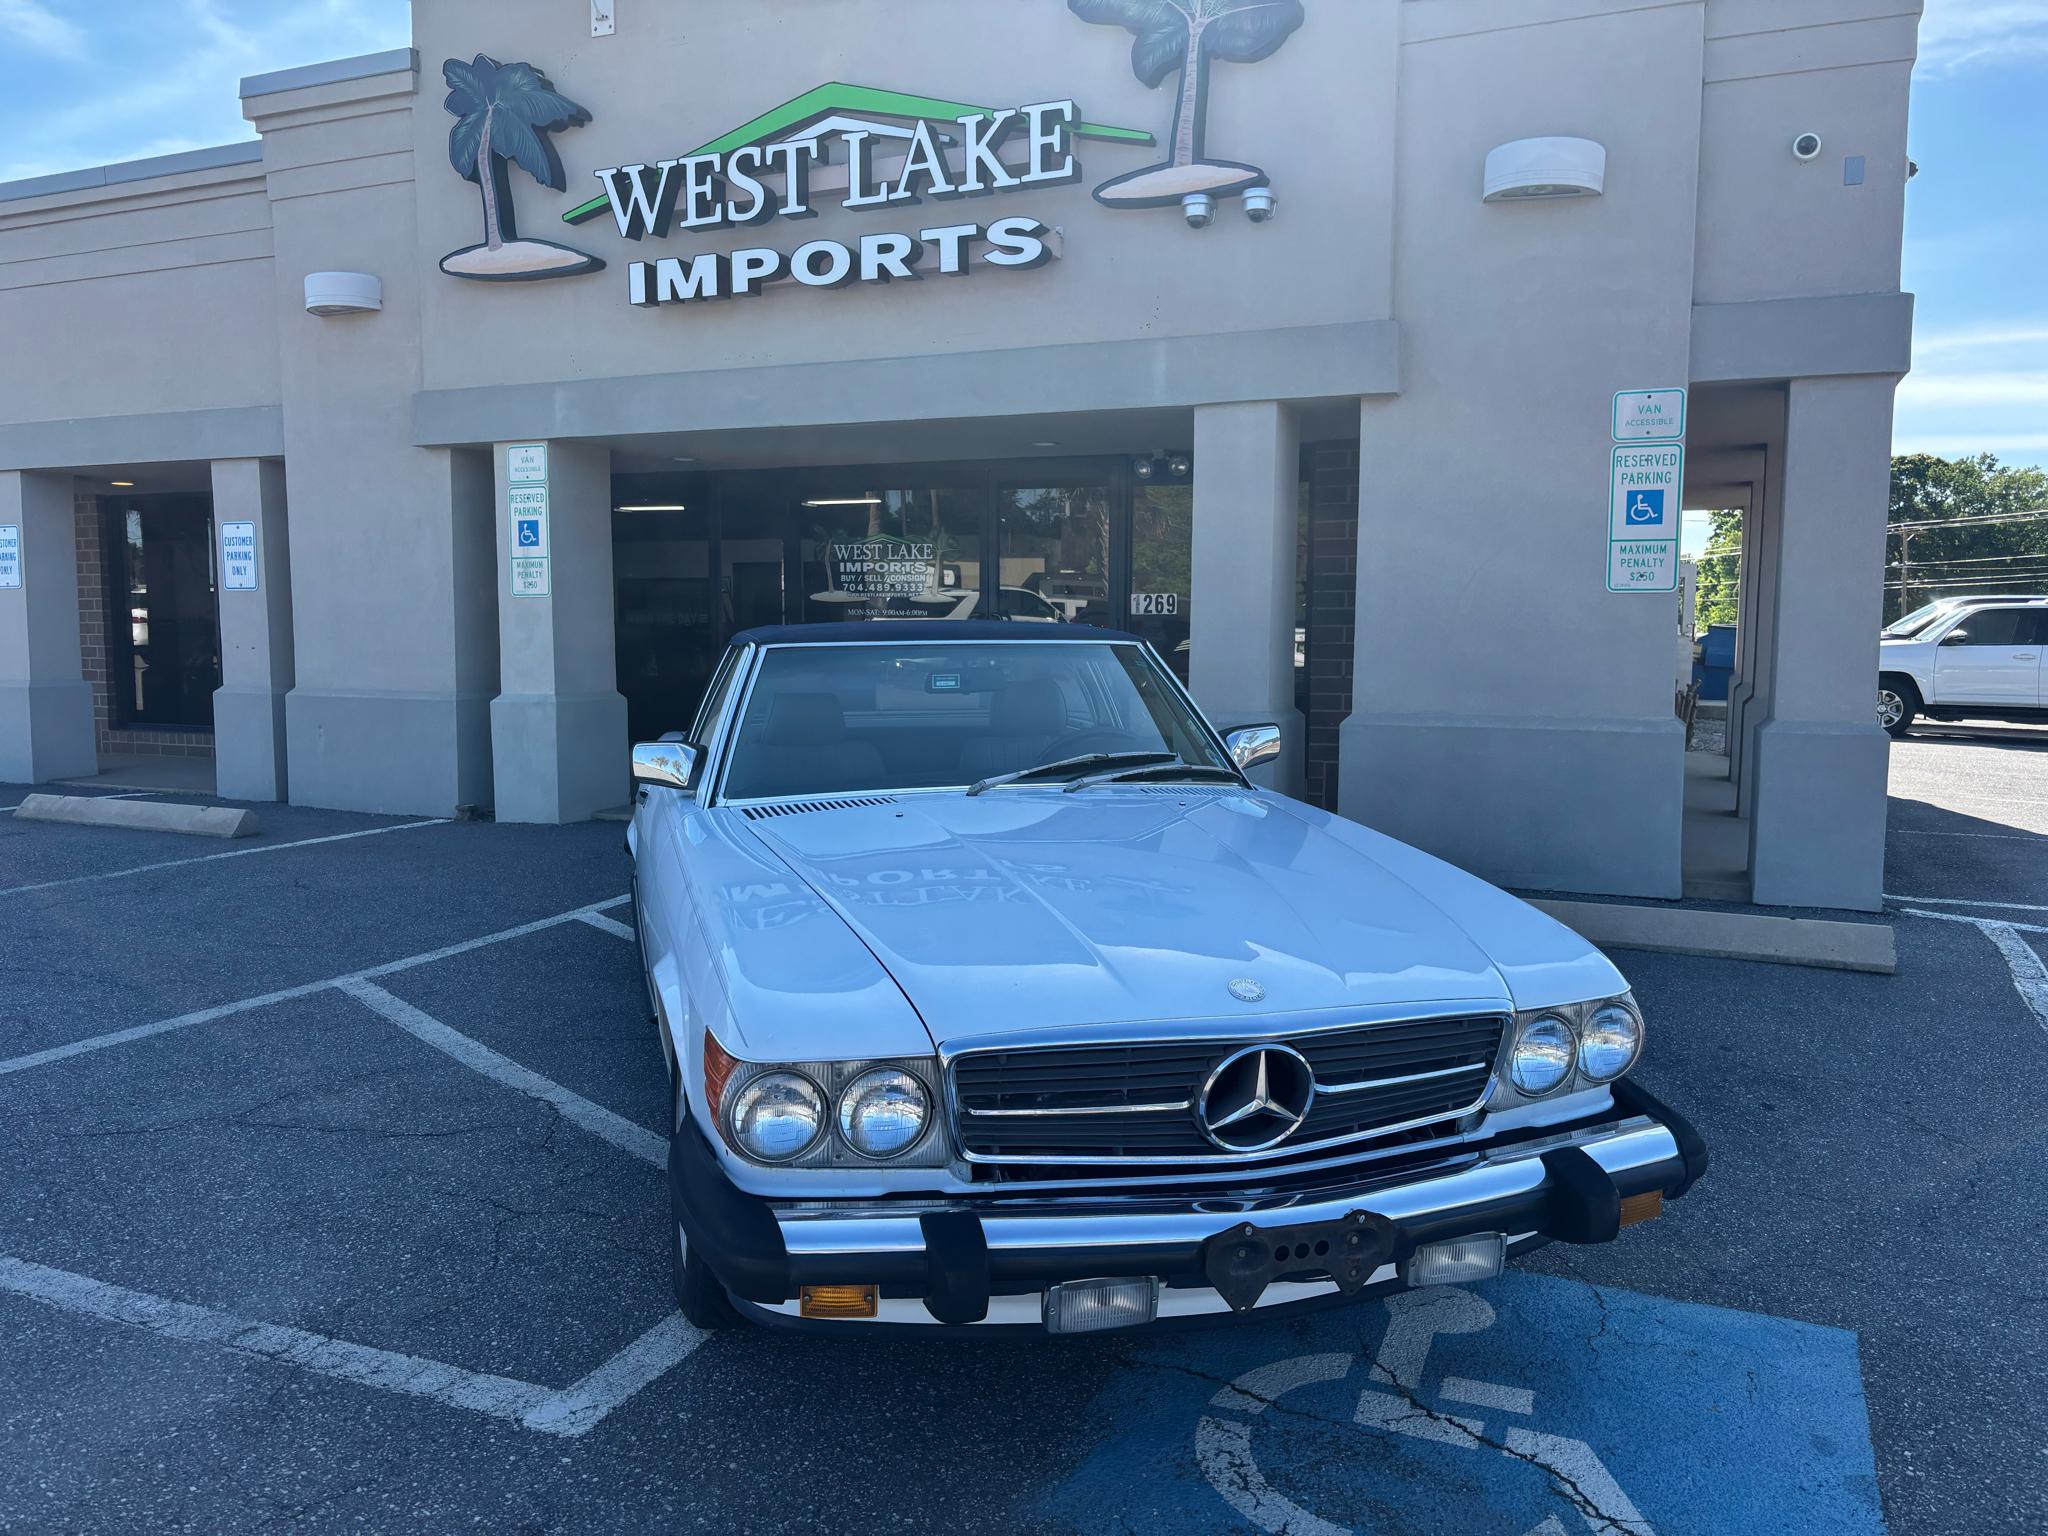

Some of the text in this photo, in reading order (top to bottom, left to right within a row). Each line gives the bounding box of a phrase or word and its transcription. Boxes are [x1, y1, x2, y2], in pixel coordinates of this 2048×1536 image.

[594, 98, 1075, 240] WEST LAKE
[628, 216, 1044, 306] IMPORTS
[1638, 404, 1662, 414] VAN
[1625, 417, 1674, 427] ACCESSIBLE
[521, 456, 534, 464] VAN
[1615, 453, 1677, 468] RESERVED
[1621, 471, 1672, 485] PARKING
[510, 493, 545, 504] RESERVED
[514, 506, 543, 517] PARKING
[224, 536, 253, 547] CUSTOMER
[834, 543, 933, 560] WEST LAKE
[1619, 544, 1667, 555] MAXIMUM
[226, 551, 252, 561] PARKING
[516, 561, 544, 569] MAXIMUM
[840, 562, 928, 572] IMPORTS
[1620, 558, 1665, 568] PENALTY
[232, 565, 247, 576] ONLY
[517, 571, 543, 579] PENALTY
[840, 574, 856, 582] BUY
[864, 574, 883, 582] SELL
[889, 574, 926, 582] CONSIGN
[1629, 571, 1655, 582] $250
[843, 583, 924, 592] 704.489.9333
[1132, 594, 1176, 614] 1269
